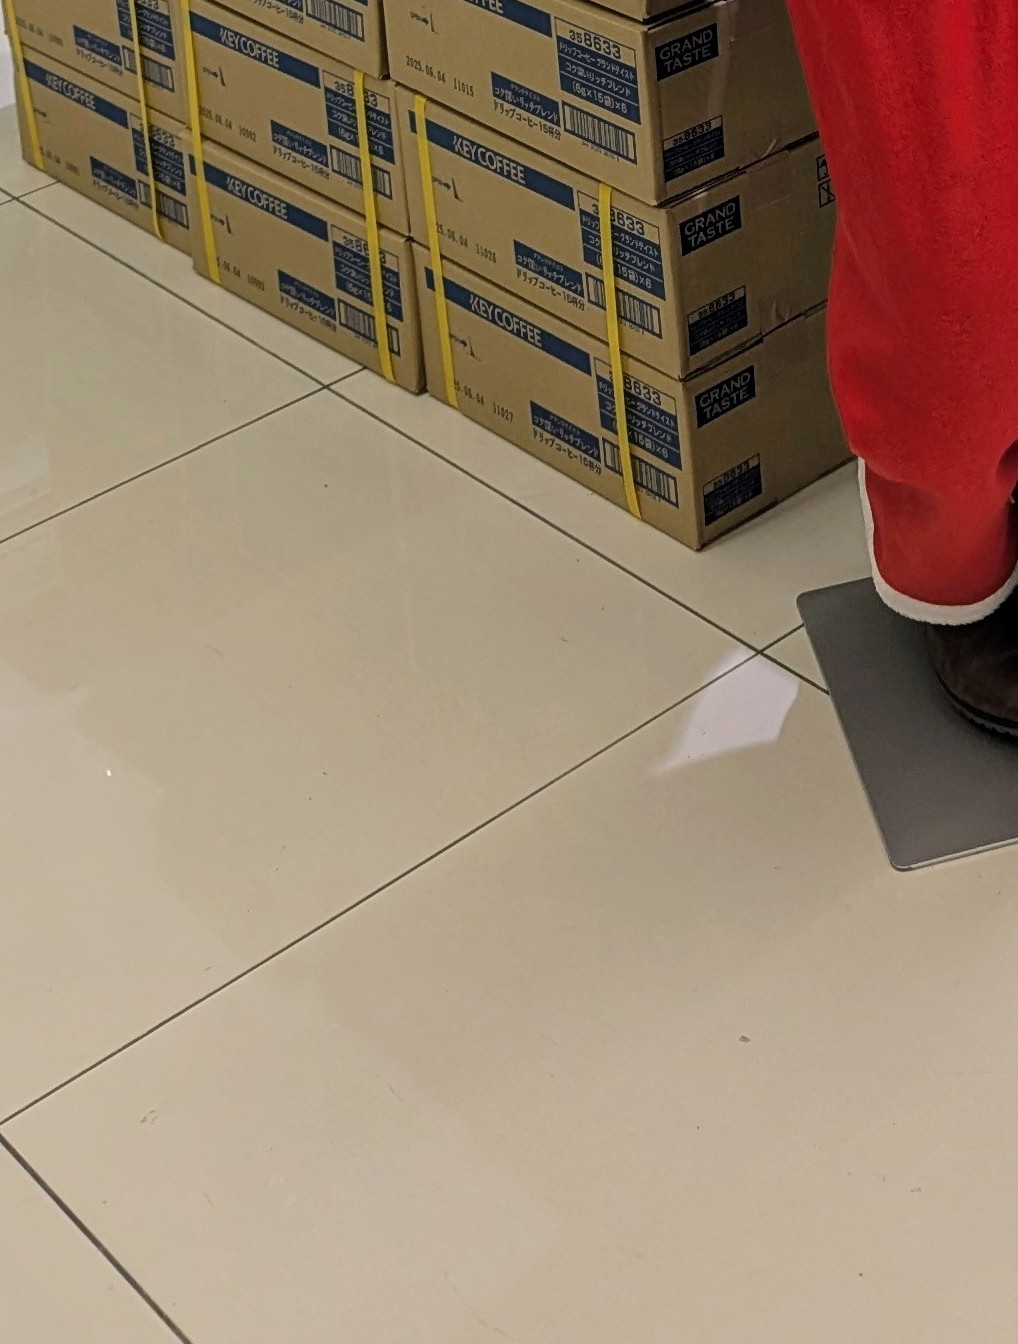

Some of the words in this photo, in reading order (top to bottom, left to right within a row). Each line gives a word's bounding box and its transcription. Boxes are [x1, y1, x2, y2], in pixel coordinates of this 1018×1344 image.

[219, 27, 240, 48] KEY
[239, 35, 280, 68] COFFEE
[568, 28, 622, 60] 358633
[659, 28, 714, 61] GRAND
[664, 43, 712, 74] TASTE
[453, 135, 478, 162] KEY
[477, 146, 526, 185] COFFEE
[684, 201, 736, 237] GRAND
[687, 217, 735, 248] TASTE
[469, 293, 495, 320] KEY
[494, 306, 543, 348] COFFEE
[699, 371, 751, 409] GRAND
[704, 386, 750, 422] TASTE
